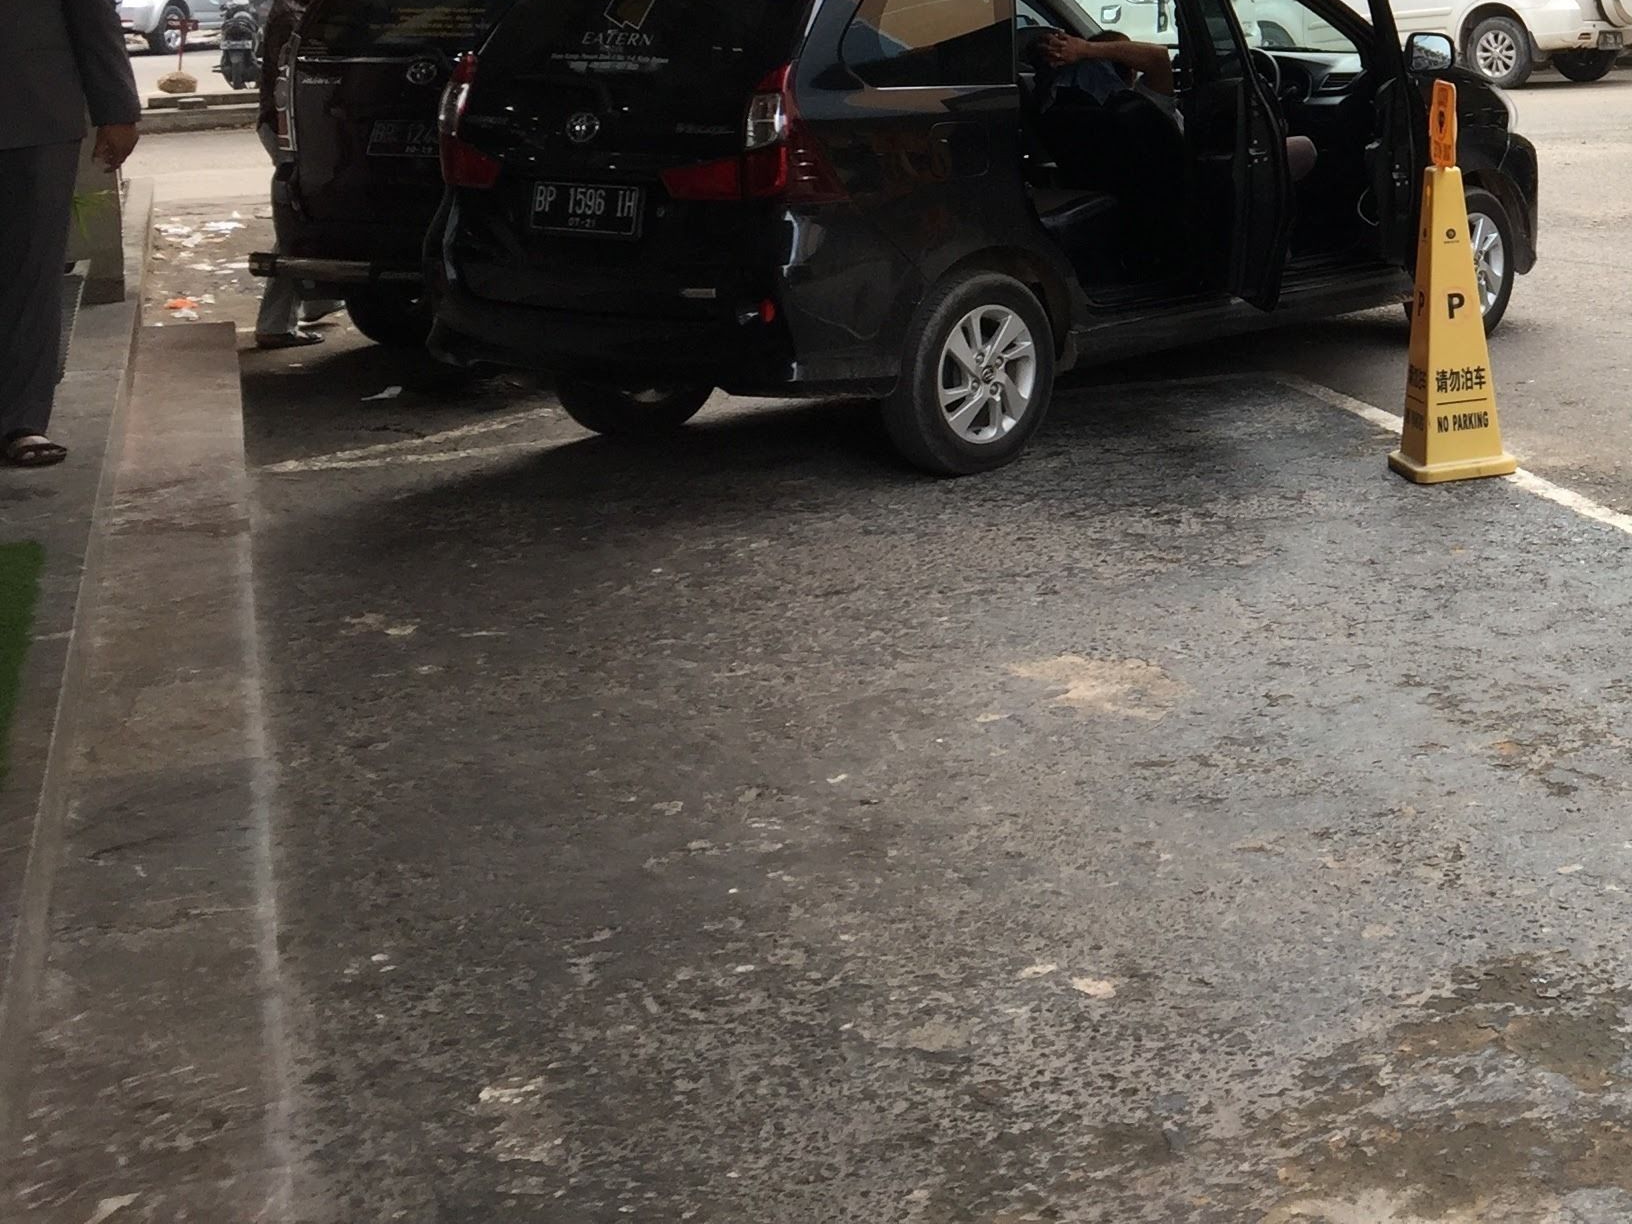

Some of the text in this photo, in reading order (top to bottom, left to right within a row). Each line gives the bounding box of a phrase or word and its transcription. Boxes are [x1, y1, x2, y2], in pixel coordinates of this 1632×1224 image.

[534, 185, 638, 218] BP 1596 IH
[1435, 366, 1487, 394] 请勿泊车
[1437, 416, 1449, 433] NO
[1452, 410, 1489, 432] PARKING
